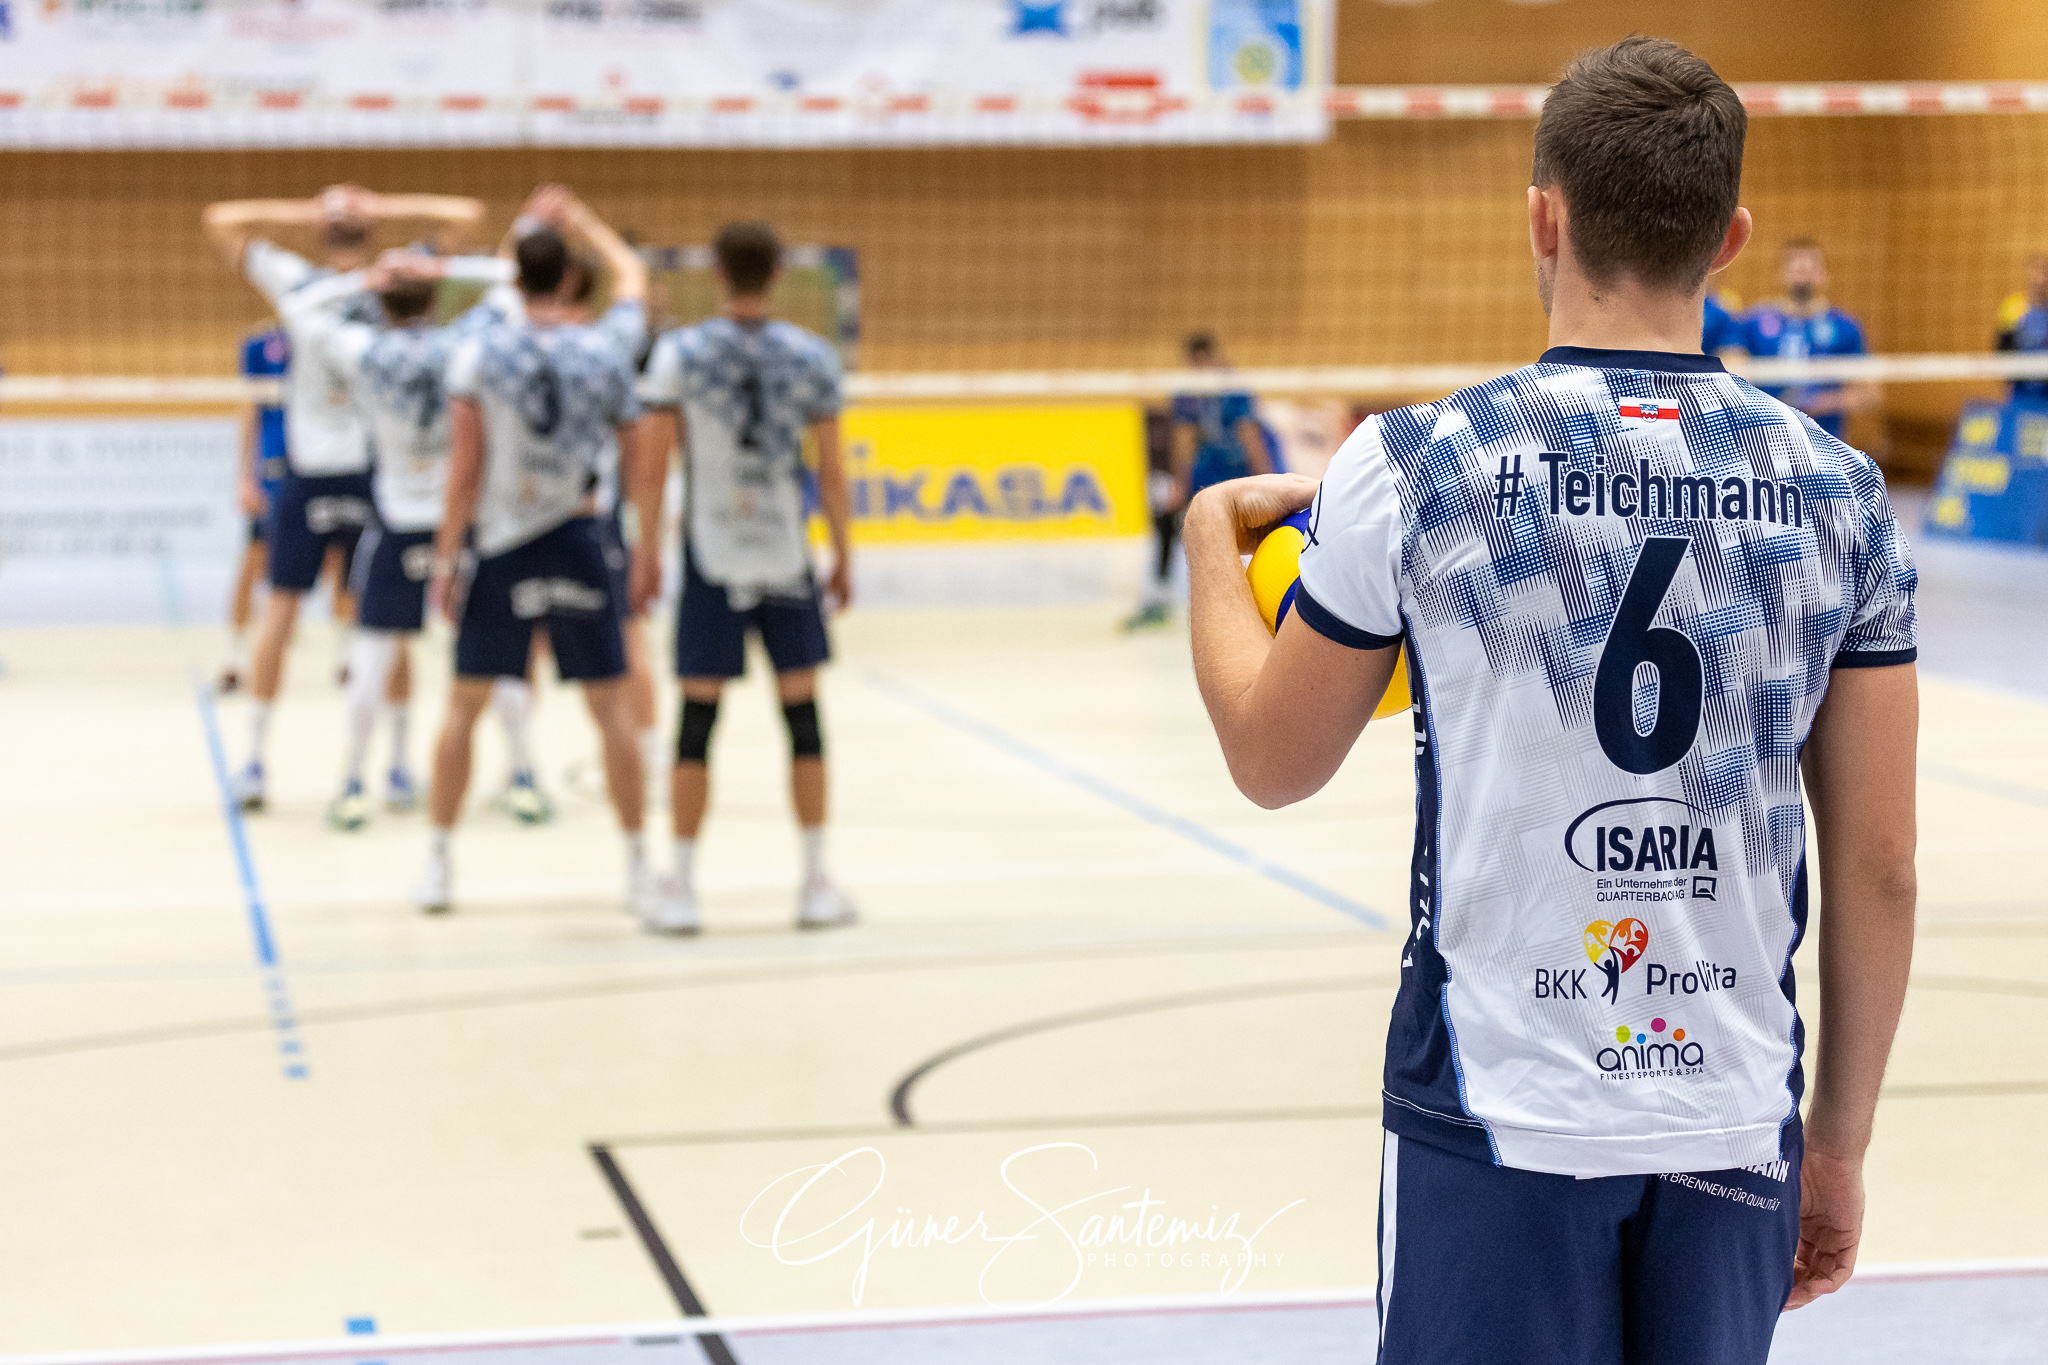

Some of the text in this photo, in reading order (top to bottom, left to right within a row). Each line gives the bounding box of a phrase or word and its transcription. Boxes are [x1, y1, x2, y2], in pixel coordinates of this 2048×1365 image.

[1493, 452, 1803, 528] # Teichmann
[1594, 536, 1702, 775] 6
[1596, 825, 1718, 872] ISARIA
[1596, 878, 1612, 889] Ein
[1673, 876, 1687, 887] der
[1535, 960, 1737, 1000] BKK ProVita
[1596, 1034, 1704, 1072] anima
[1675, 1068, 1683, 1076] &
[1685, 1066, 1704, 1075] SPA
[1740, 1160, 1790, 1183] ANN
[1669, 1172, 1728, 1198] BRENNEN
[1726, 1187, 1748, 1203] FÜR
[1746, 1194, 1781, 1212] QUALITÄT
